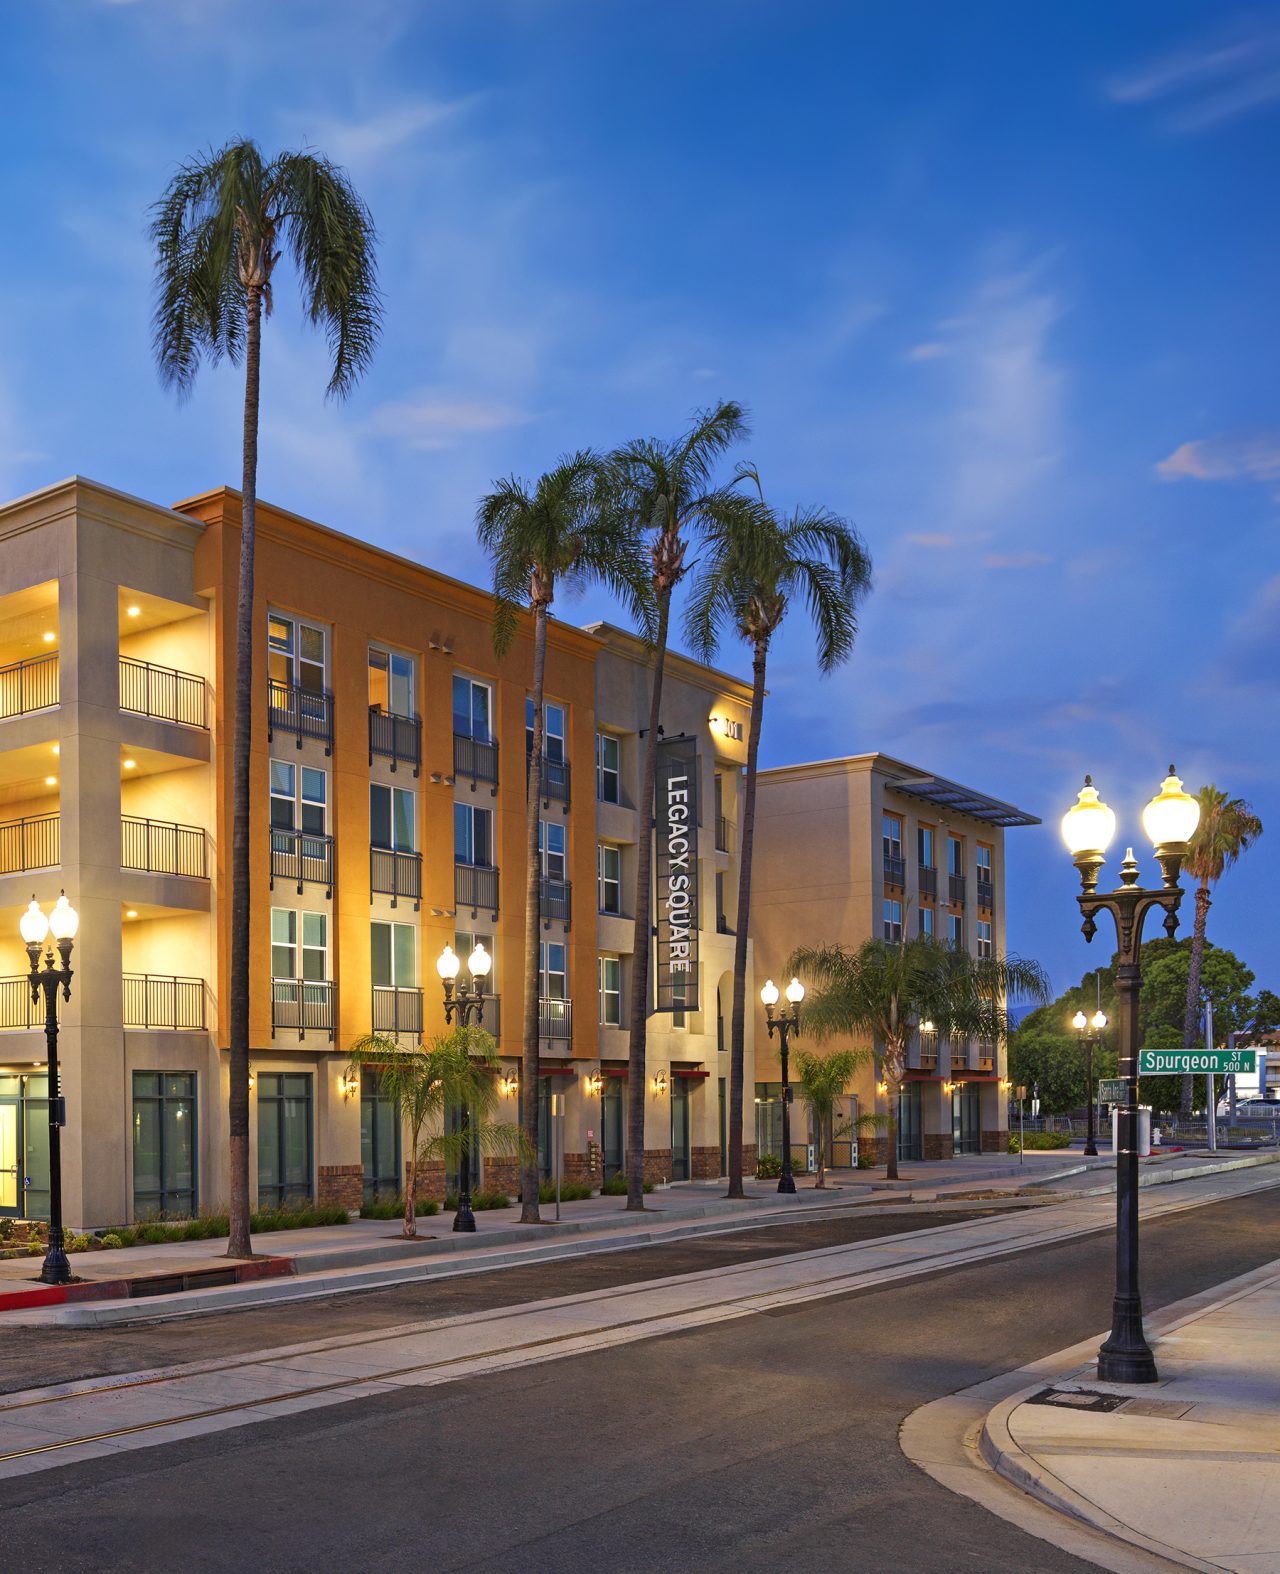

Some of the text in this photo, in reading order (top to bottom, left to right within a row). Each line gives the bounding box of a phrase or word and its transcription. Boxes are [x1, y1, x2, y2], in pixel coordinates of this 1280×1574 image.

[665, 775, 690, 973] LEGACY SQUARE
[1145, 1052, 1242, 1072] Spurgeon ST
[1223, 1062, 1250, 1071] 500 N
